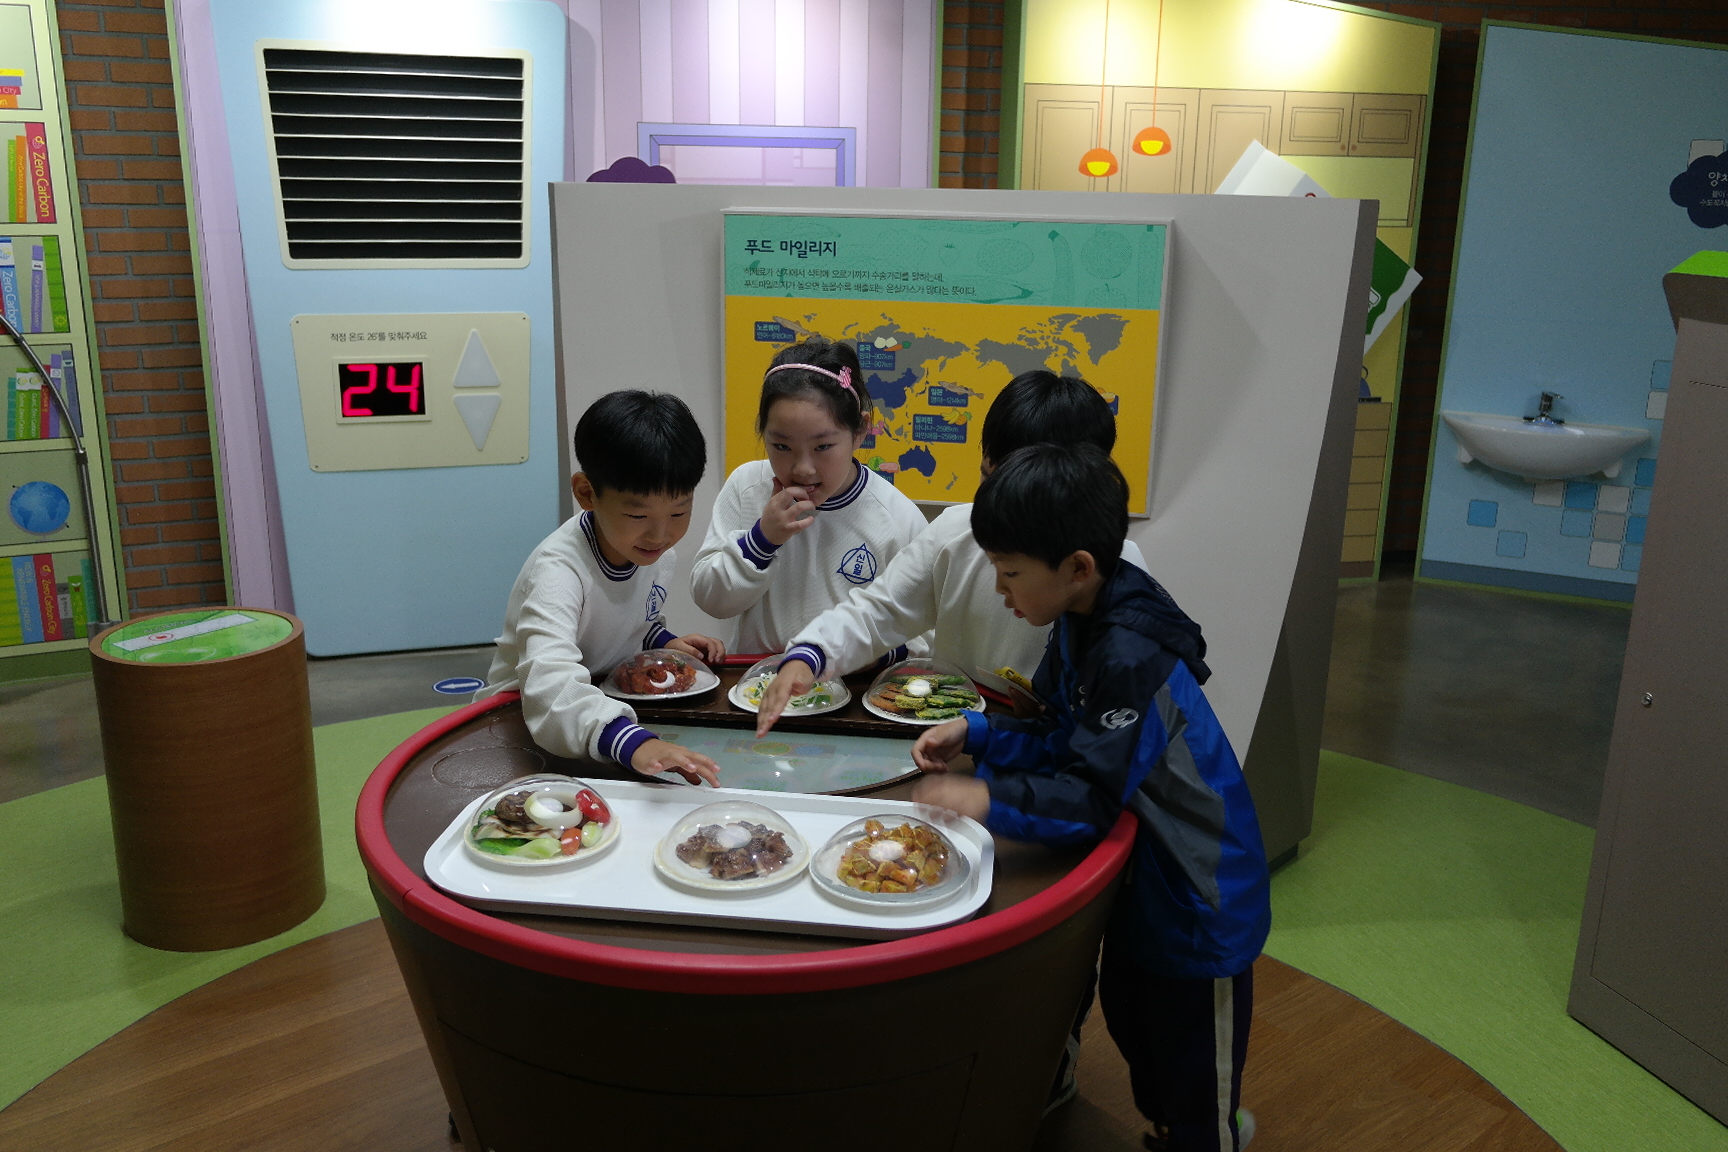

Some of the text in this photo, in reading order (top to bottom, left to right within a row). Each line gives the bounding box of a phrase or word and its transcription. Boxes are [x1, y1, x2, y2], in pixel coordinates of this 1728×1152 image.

[33, 152, 51, 217] Zero Carbon
[744, 239, 837, 259] 푸드 마일리지
[2, 270, 13, 292] Zero
[832, 270, 870, 279] 오르기까지
[330, 332, 346, 342] 적정
[348, 332, 366, 342] 온도
[388, 331, 428, 342] 맞춰주세요
[342, 364, 420, 416] 24
[42, 579, 57, 634] Zero Carbon City
